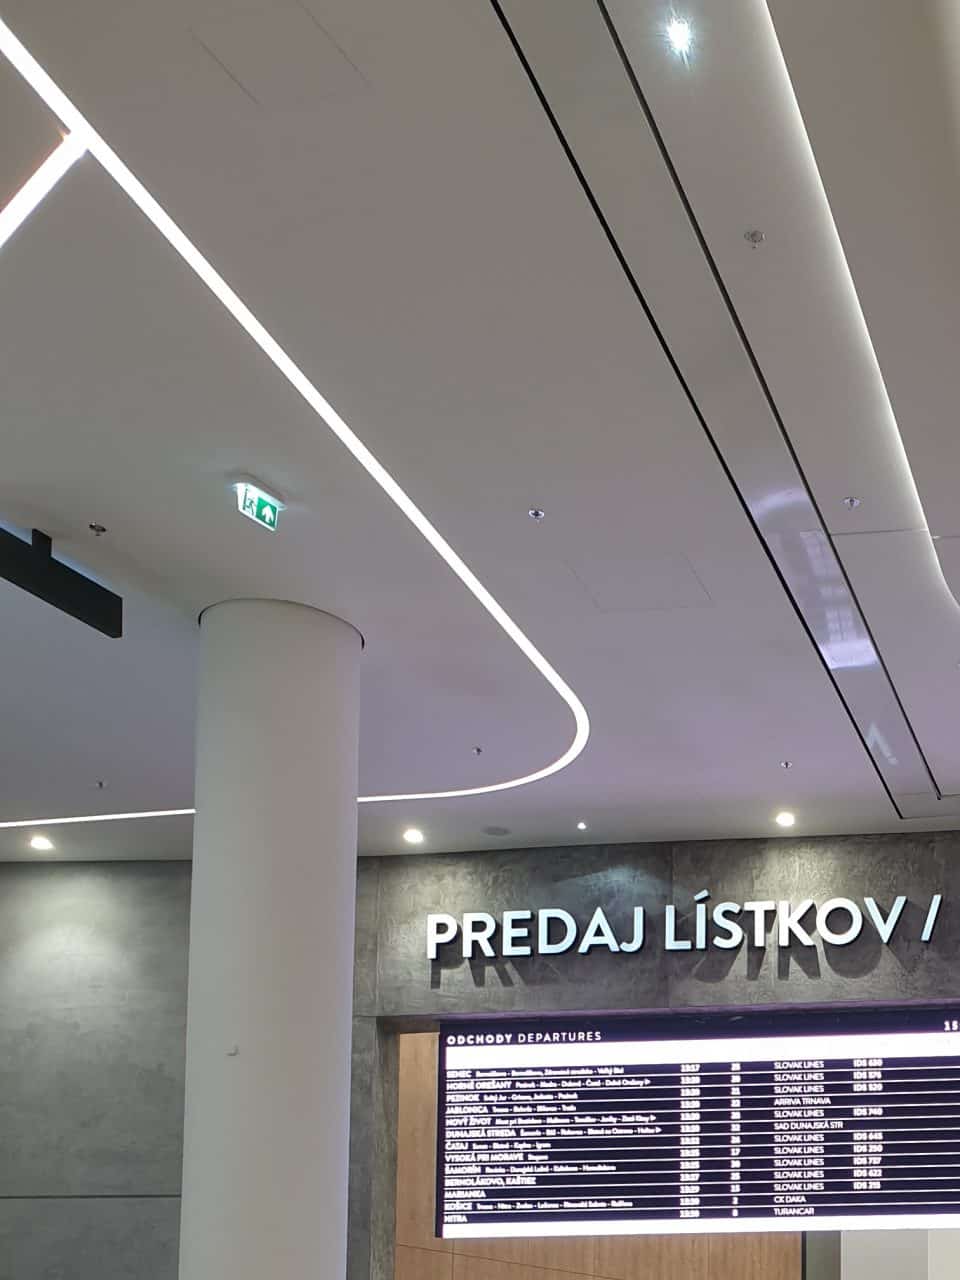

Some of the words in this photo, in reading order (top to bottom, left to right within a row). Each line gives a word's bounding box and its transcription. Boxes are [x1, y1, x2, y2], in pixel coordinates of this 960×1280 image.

[427, 906, 645, 960] PREDAJ
[665, 889, 907, 951] LÍSTKOV
[446, 1034, 513, 1046] ODCHODY
[518, 1031, 602, 1044] DEPARTURES
[774, 1110, 803, 1118] SLOVAK
